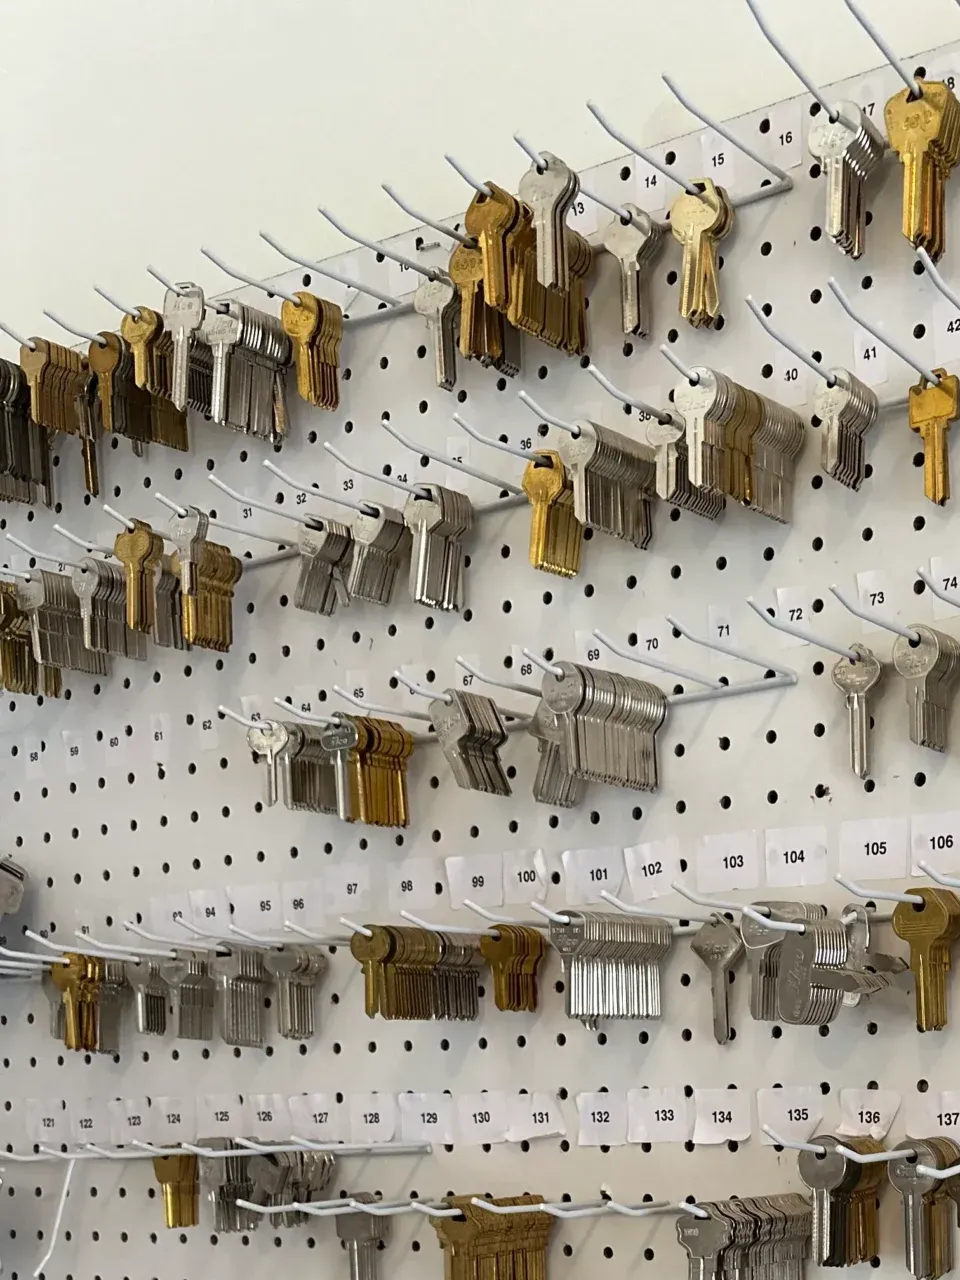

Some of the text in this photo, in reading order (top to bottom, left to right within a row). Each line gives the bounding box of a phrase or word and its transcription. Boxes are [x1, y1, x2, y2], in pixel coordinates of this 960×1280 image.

[779, 131, 792, 146] 16
[711, 153, 725, 167] 15
[645, 175, 657, 188] 14
[572, 202, 585, 216] 13
[863, 346, 878, 360] 41
[520, 439, 531, 449] 36
[344, 480, 354, 490] 33
[296, 495, 307, 504] 32
[243, 508, 252, 518] 31
[943, 577, 958, 590] 74
[870, 592, 884, 605] 73
[789, 609, 802, 620] 72
[717, 626, 730, 637] 71
[646, 638, 658, 650] 70
[588, 650, 599, 660] 69
[520, 664, 532, 675] 68
[463, 675, 473, 686] 67
[354, 688, 364, 698] 65
[301, 703, 311, 713] 64
[203, 720, 212, 730] 62
[154, 731, 163, 741] 61
[110, 737, 119, 747] 60
[70, 746, 79, 756] 59
[930, 835, 953, 850] 106
[864, 842, 887, 856] 105
[723, 854, 744, 870] 103
[783, 850, 805, 864] 104
[590, 869, 608, 881] 101
[642, 862, 662, 877] 102
[472, 876, 484, 887] 99
[517, 870, 536, 882] 100
[347, 883, 357, 894] 97
[401, 880, 413, 892] 98
[260, 900, 271, 911] 95
[293, 899, 304, 910] 96
[205, 907, 215, 917] 94
[81, 925, 90, 934] 91
[167, 1114, 181, 1123] 124
[215, 1112, 229, 1122] 125
[257, 1111, 272, 1121] 126
[313, 1112, 328, 1123] 127
[363, 1113, 380, 1124] 128
[421, 1112, 438, 1124] 129
[472, 1111, 490, 1124] 130
[532, 1112, 549, 1124] 131
[591, 1111, 610, 1123] 132
[655, 1110, 674, 1122] 133
[712, 1110, 732, 1123] 134
[788, 1108, 808, 1121] 135
[858, 1111, 880, 1124] 136
[937, 1112, 960, 1126] 137
[42, 1119, 54, 1127] 121
[80, 1119, 93, 1128] 122
[128, 1116, 141, 1126] 123
